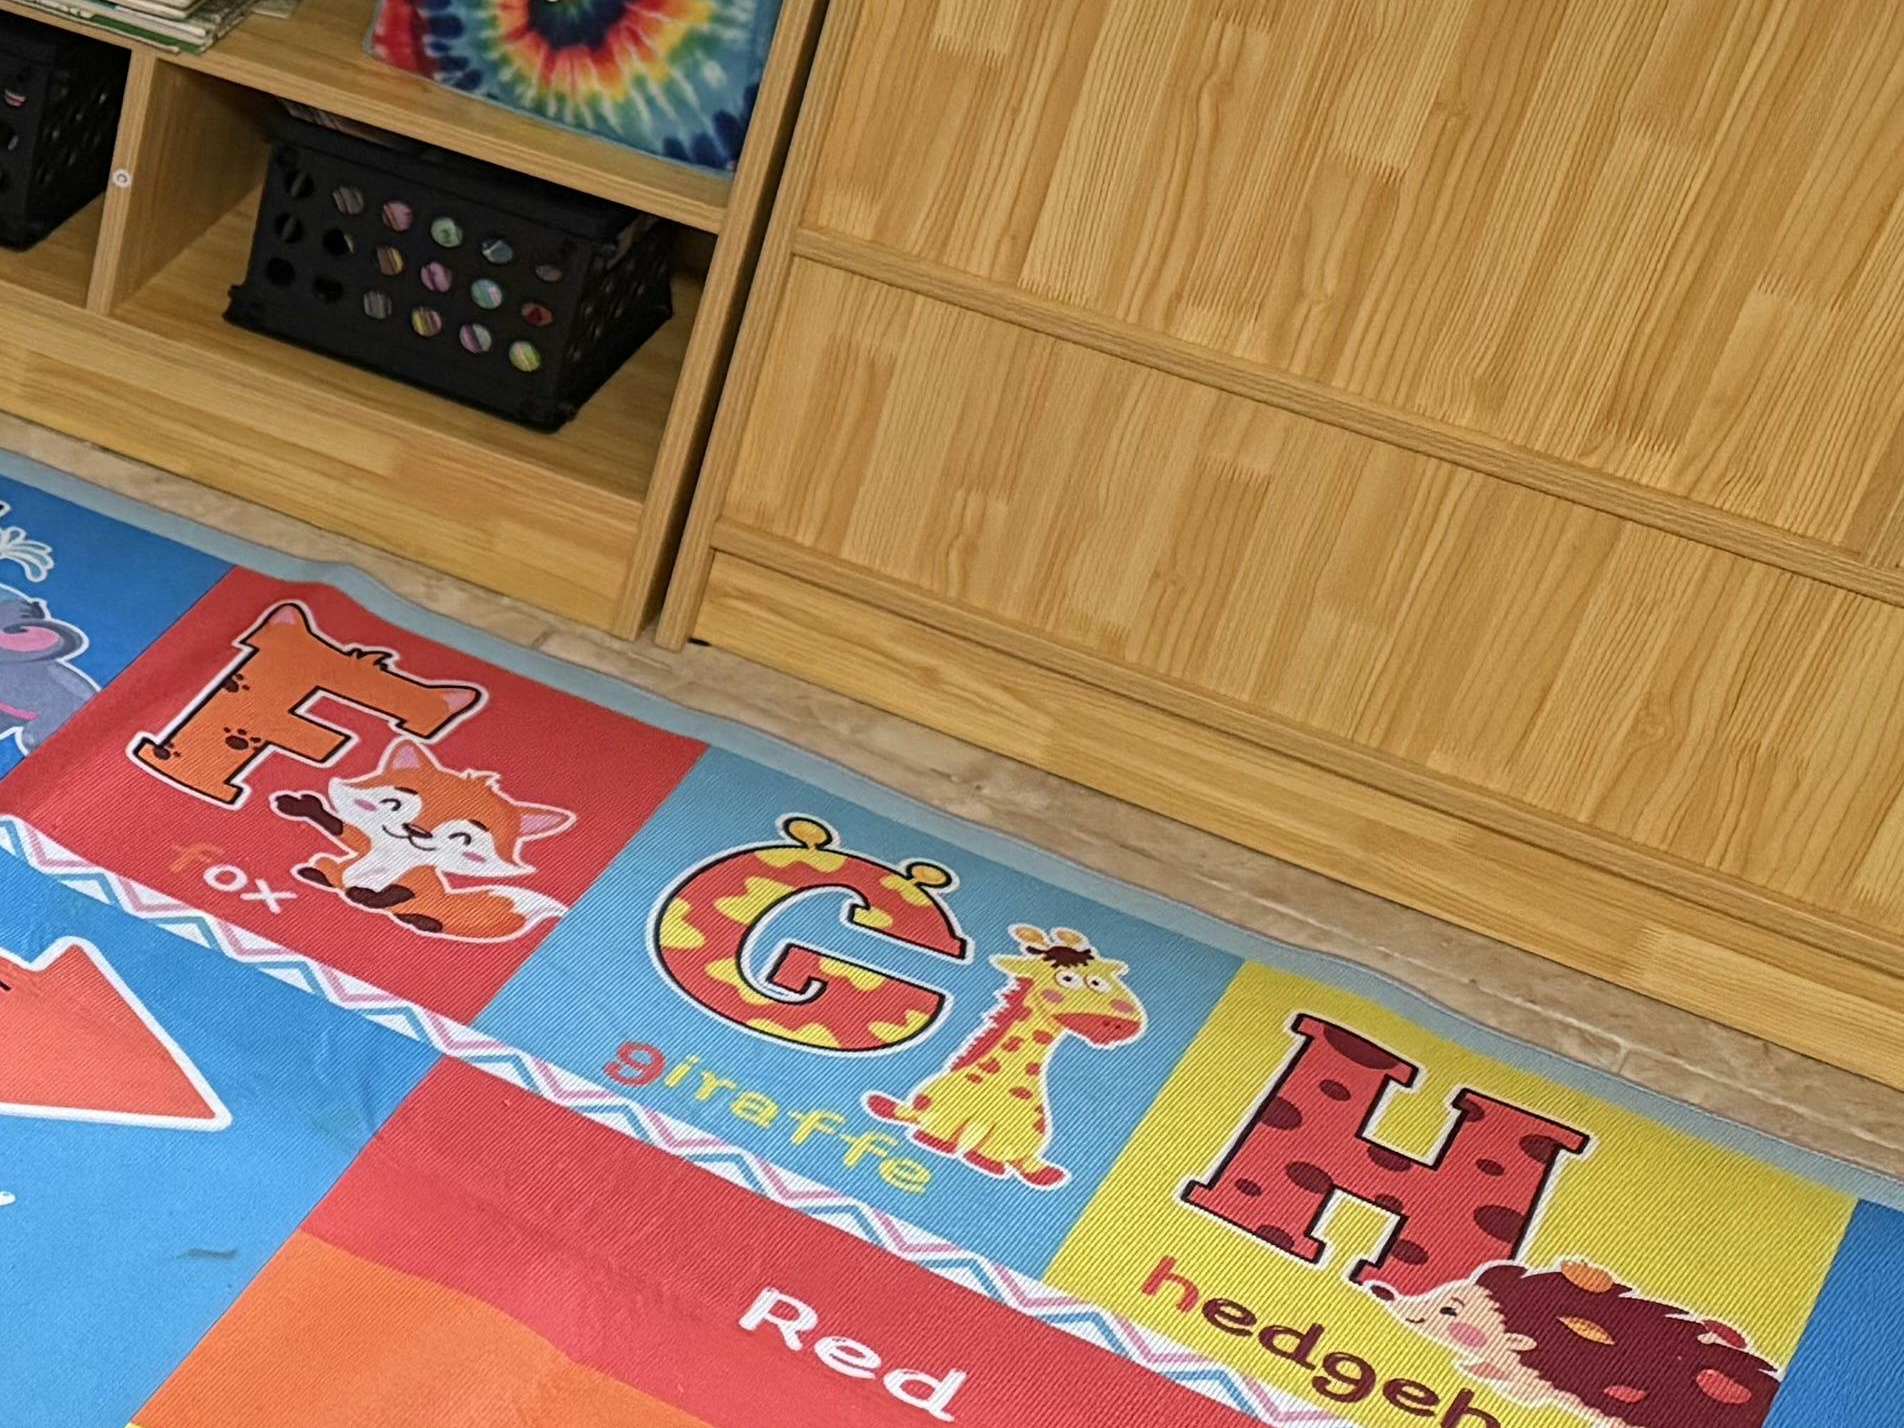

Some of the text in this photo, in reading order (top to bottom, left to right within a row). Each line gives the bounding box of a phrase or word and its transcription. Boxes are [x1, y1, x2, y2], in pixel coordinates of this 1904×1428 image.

[126, 599, 488, 810] F
[166, 842, 298, 915] fox
[646, 814, 973, 1060] G
[600, 1039, 933, 1197] giraffe
[1178, 1009, 1595, 1292] H
[736, 1285, 971, 1423] Red
